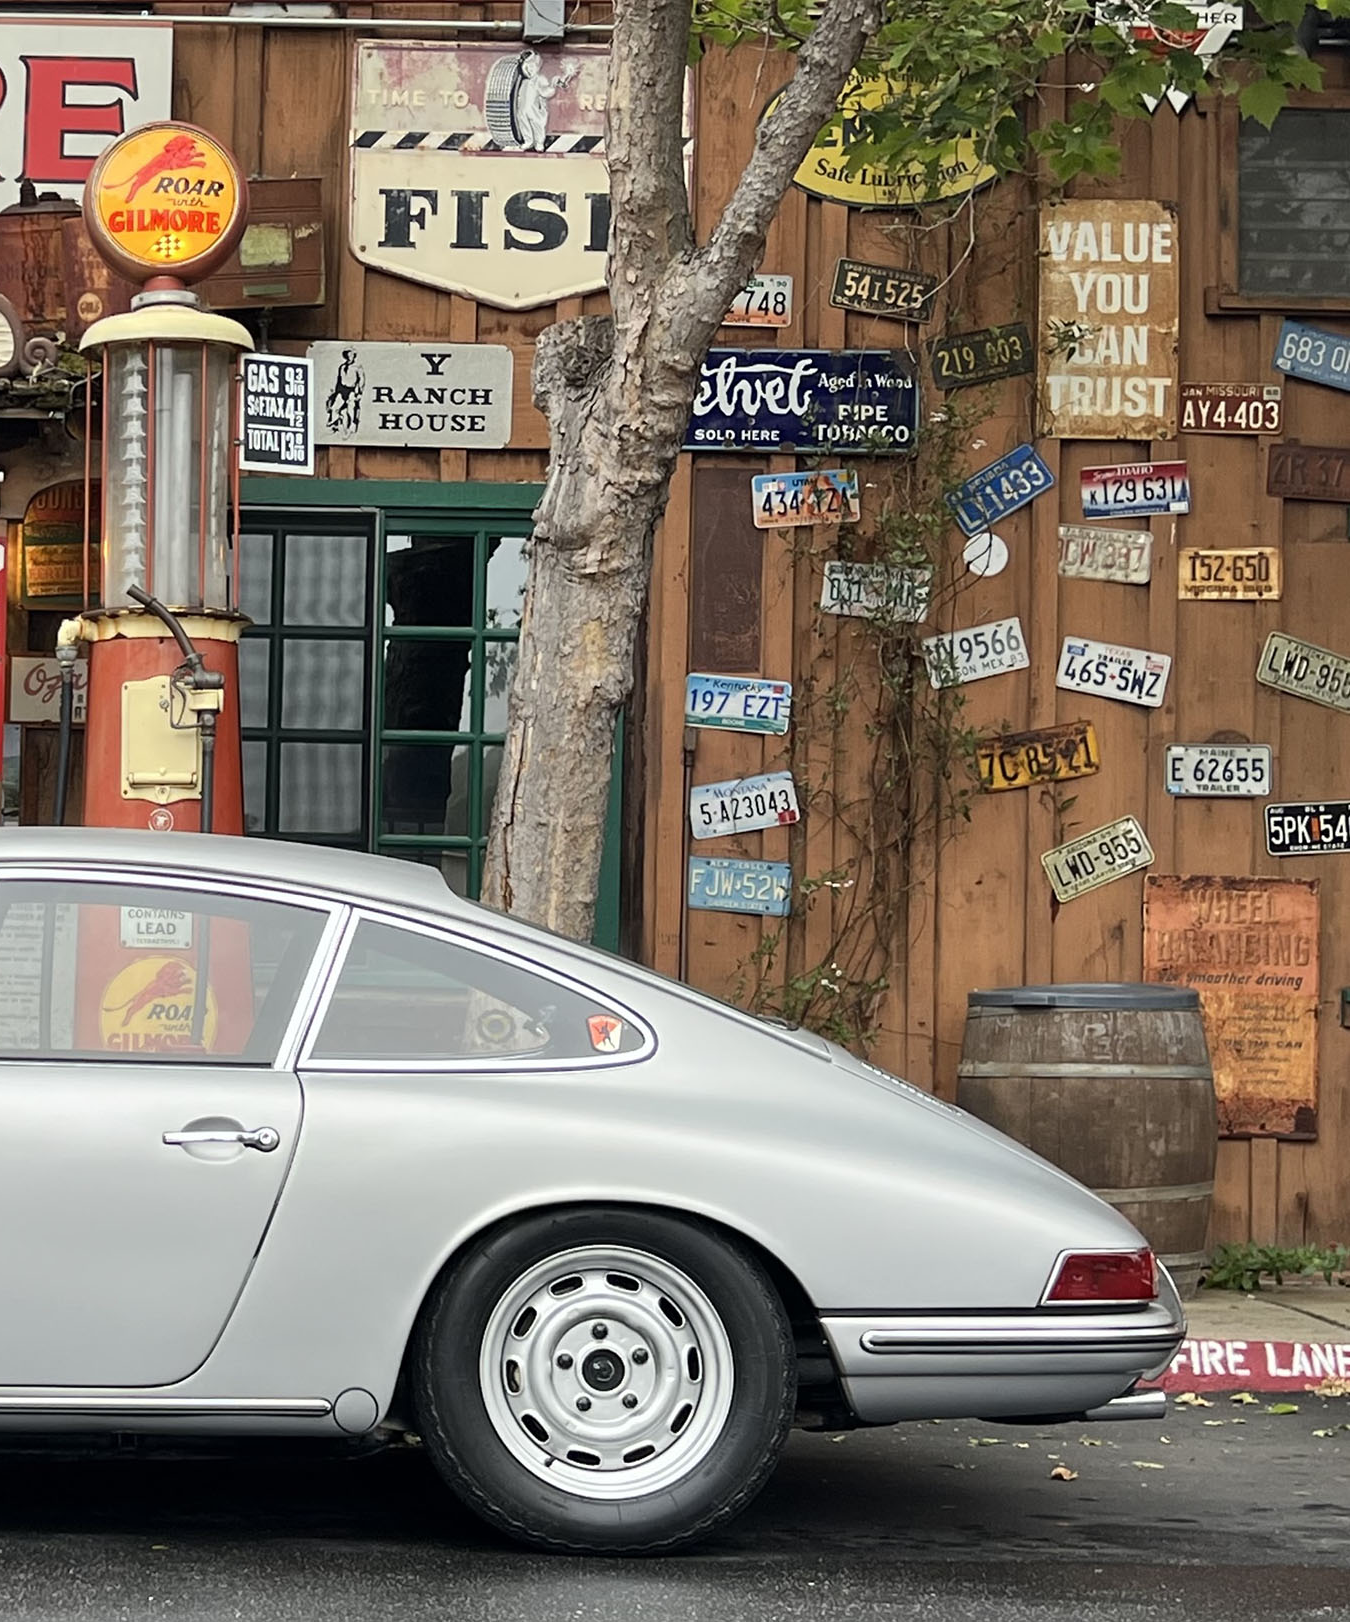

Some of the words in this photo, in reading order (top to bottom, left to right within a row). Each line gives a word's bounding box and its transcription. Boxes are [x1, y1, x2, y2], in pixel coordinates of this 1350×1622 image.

[367, 89, 426, 106] TIME
[438, 90, 470, 109] TO
[814, 157, 855, 184] Safe
[153, 177, 224, 198] ROAR
[108, 211, 221, 234] GILMORE
[1048, 221, 1172, 264] VALUE
[1070, 272, 1149, 315] YOU
[1283, 332, 1326, 367] 683
[421, 353, 452, 376] Y
[938, 346, 974, 376] 219
[247, 362, 279, 393] GAS
[693, 356, 818, 416] elvet
[817, 373, 856, 391] Aged
[372, 386, 493, 406] RANCH
[1046, 376, 1172, 419] TRUST
[1182, 387, 1202, 396] JAN
[1206, 386, 1259, 397] MISSOURI
[378, 413, 486, 432] HOUSE
[838, 405, 888, 422] PIPE
[248, 429, 280, 451] TOTAL
[695, 429, 735, 441] SOLD
[741, 429, 780, 441] HERE
[1115, 465, 1154, 477] IDAHO
[762, 490, 800, 517] 434
[959, 626, 1020, 662] 9566
[982, 658, 1004, 669] MEX
[712, 680, 764, 693] Kentucky
[691, 688, 730, 714] 197
[743, 694, 784, 720] EZT
[1199, 749, 1237, 757] MAINE
[1193, 758, 1266, 783] 62655
[1196, 784, 1241, 793] TRAILER
[1319, 814, 1350, 843] 54
[710, 860, 730, 868] NEW
[1054, 829, 1142, 887] LWD-955
[127, 908, 185, 920] CONTAINS
[136, 922, 177, 936] LEAD
[1255, 974, 1304, 991] driving
[1171, 1340, 1250, 1376] FIRE
[1264, 1343, 1350, 1377] LANE
